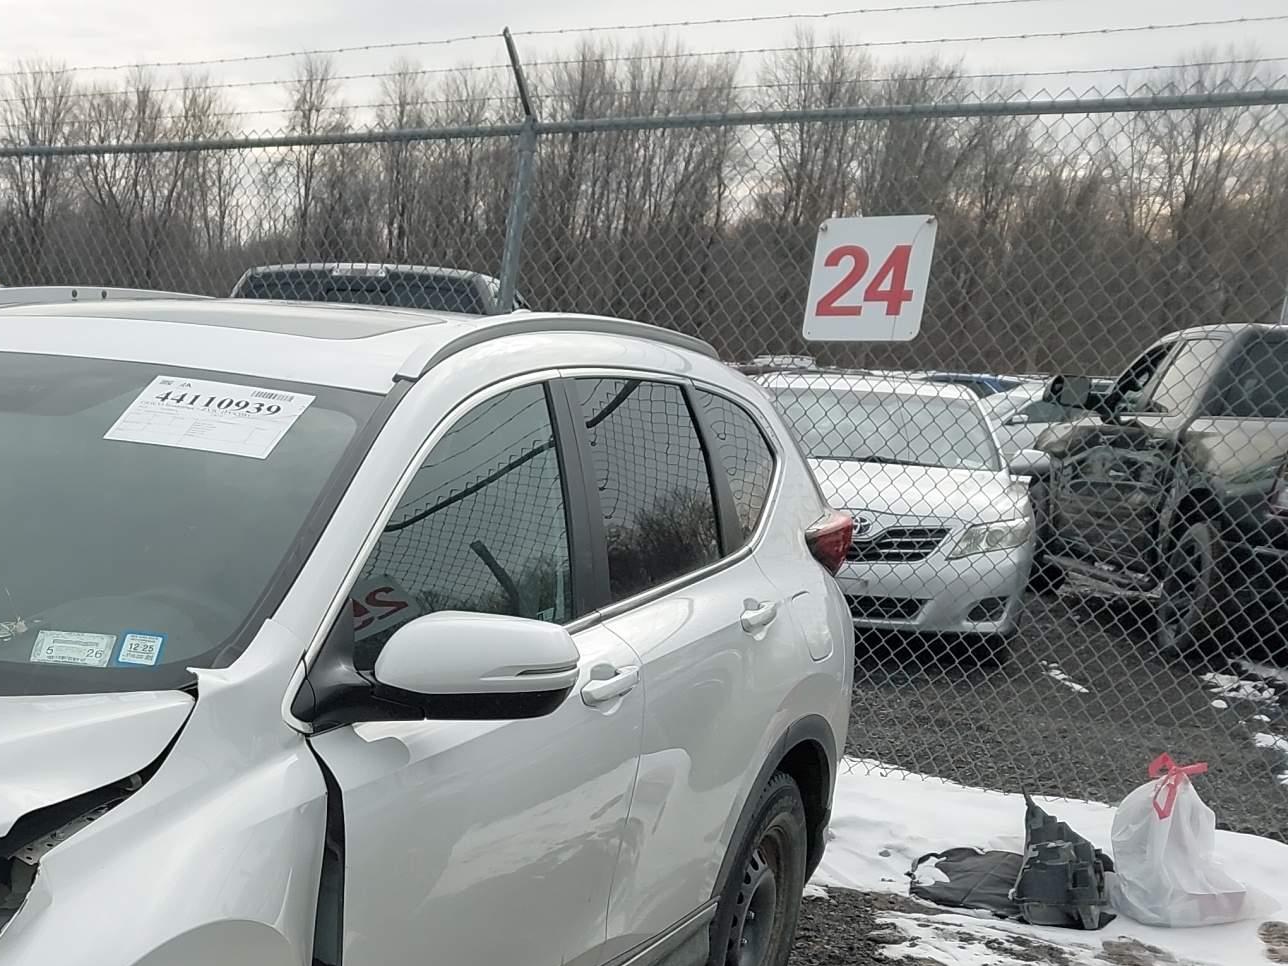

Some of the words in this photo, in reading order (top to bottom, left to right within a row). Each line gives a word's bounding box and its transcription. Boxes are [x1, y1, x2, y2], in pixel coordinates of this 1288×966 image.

[815, 244, 914, 316] 24
[155, 390, 282, 416] 44110939
[45, 646, 54, 655] 5
[85, 648, 104, 659] 26
